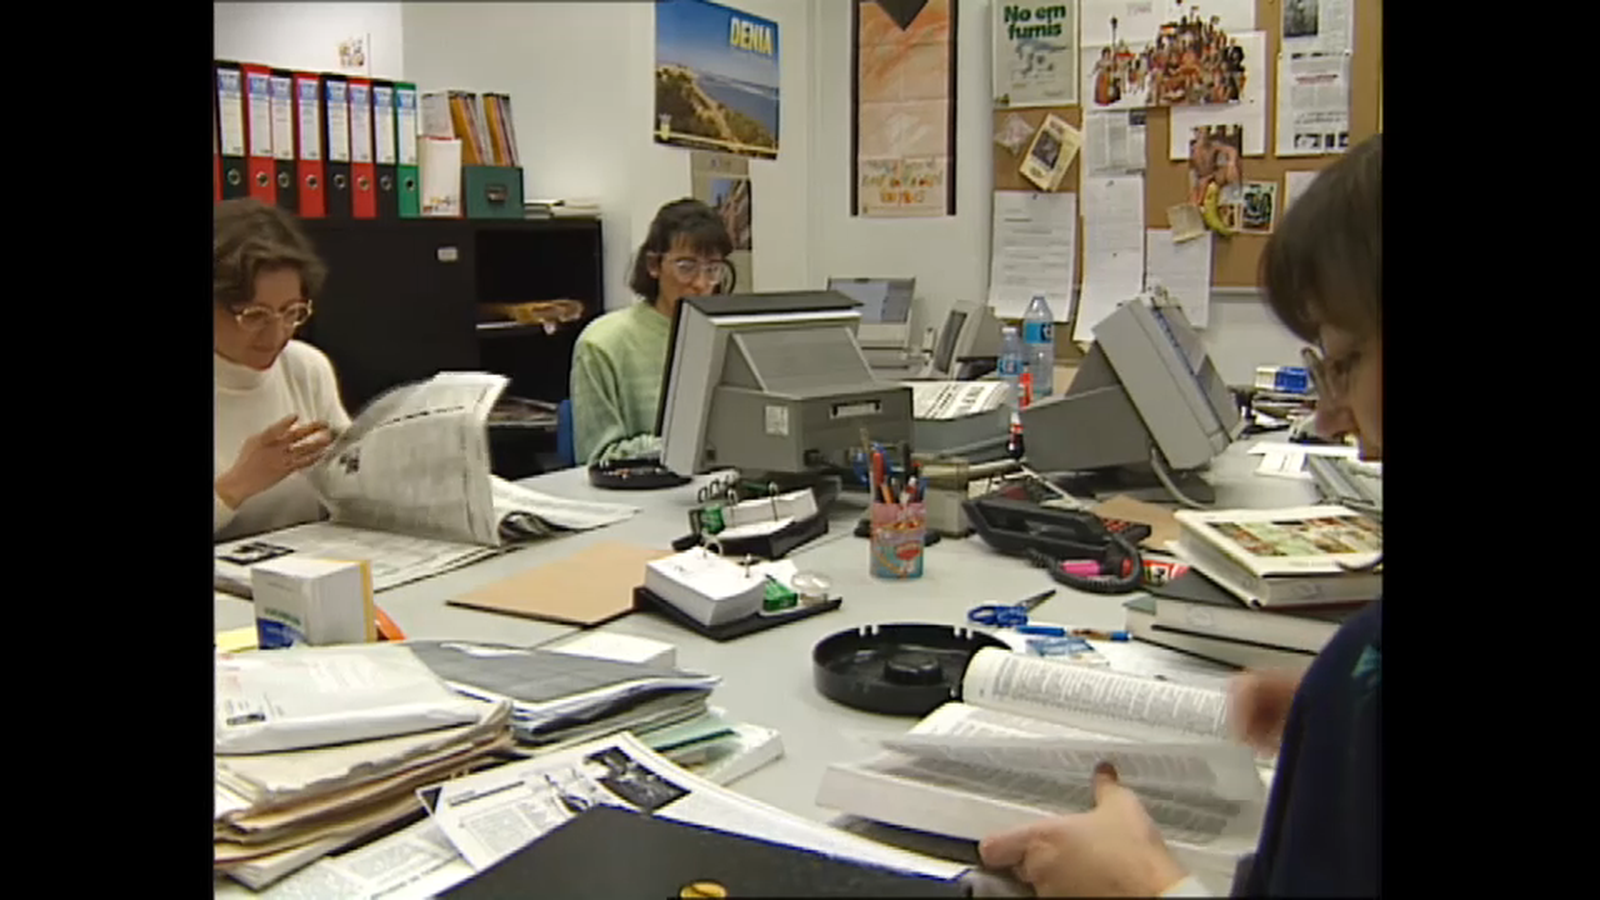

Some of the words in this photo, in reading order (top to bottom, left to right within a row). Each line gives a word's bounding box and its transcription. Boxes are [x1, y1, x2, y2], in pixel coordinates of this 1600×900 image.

[1004, 6, 1032, 22] No
[1035, 5, 1067, 19] em
[731, 17, 774, 55] DENIA
